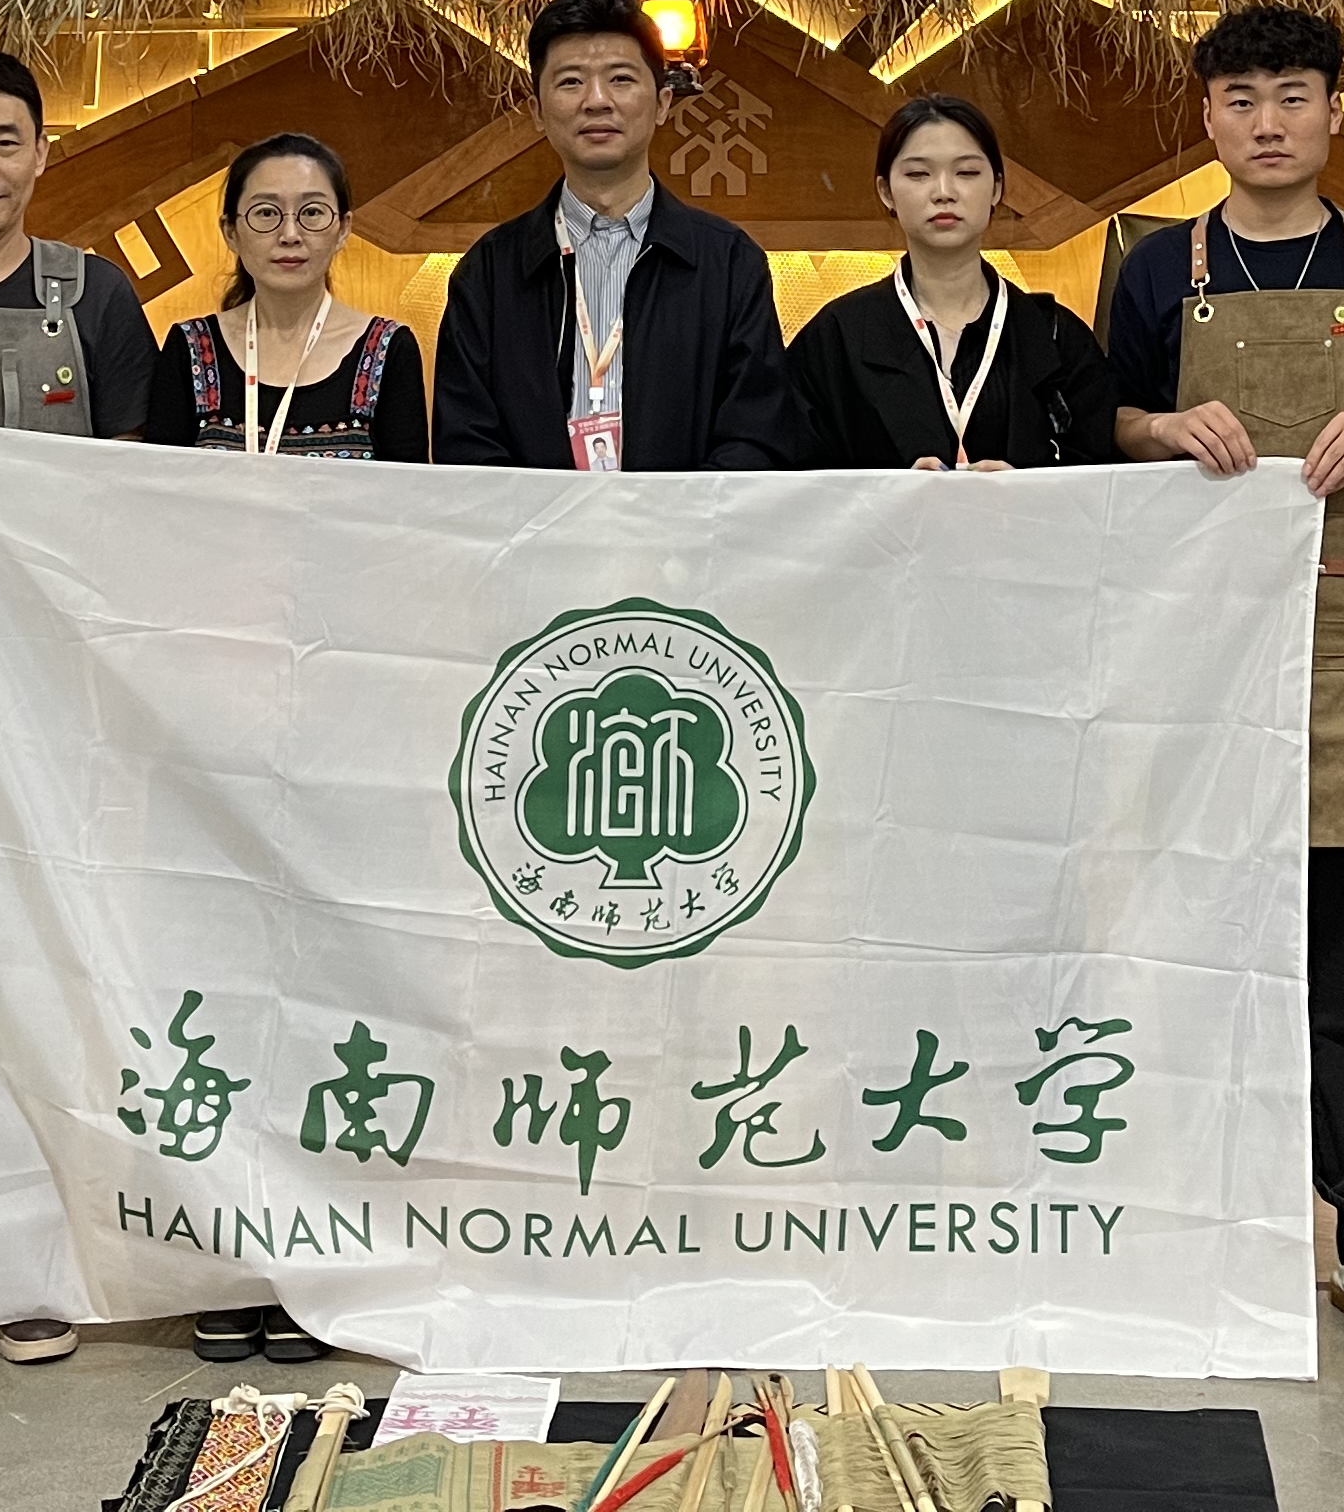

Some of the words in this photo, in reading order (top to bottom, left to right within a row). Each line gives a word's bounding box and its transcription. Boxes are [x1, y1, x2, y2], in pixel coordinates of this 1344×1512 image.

[484, 678, 543, 802] HAINAN
[543, 632, 675, 682] NORMAL
[688, 645, 783, 802] UNIVERSITY
[512, 862, 740, 936] 海南师范大学
[116, 989, 1138, 1196] 海南师范大学
[117, 1190, 374, 1261] HAINAN
[404, 1204, 702, 1259] NORMAL
[734, 1200, 1126, 1258] UNIVERSITY
